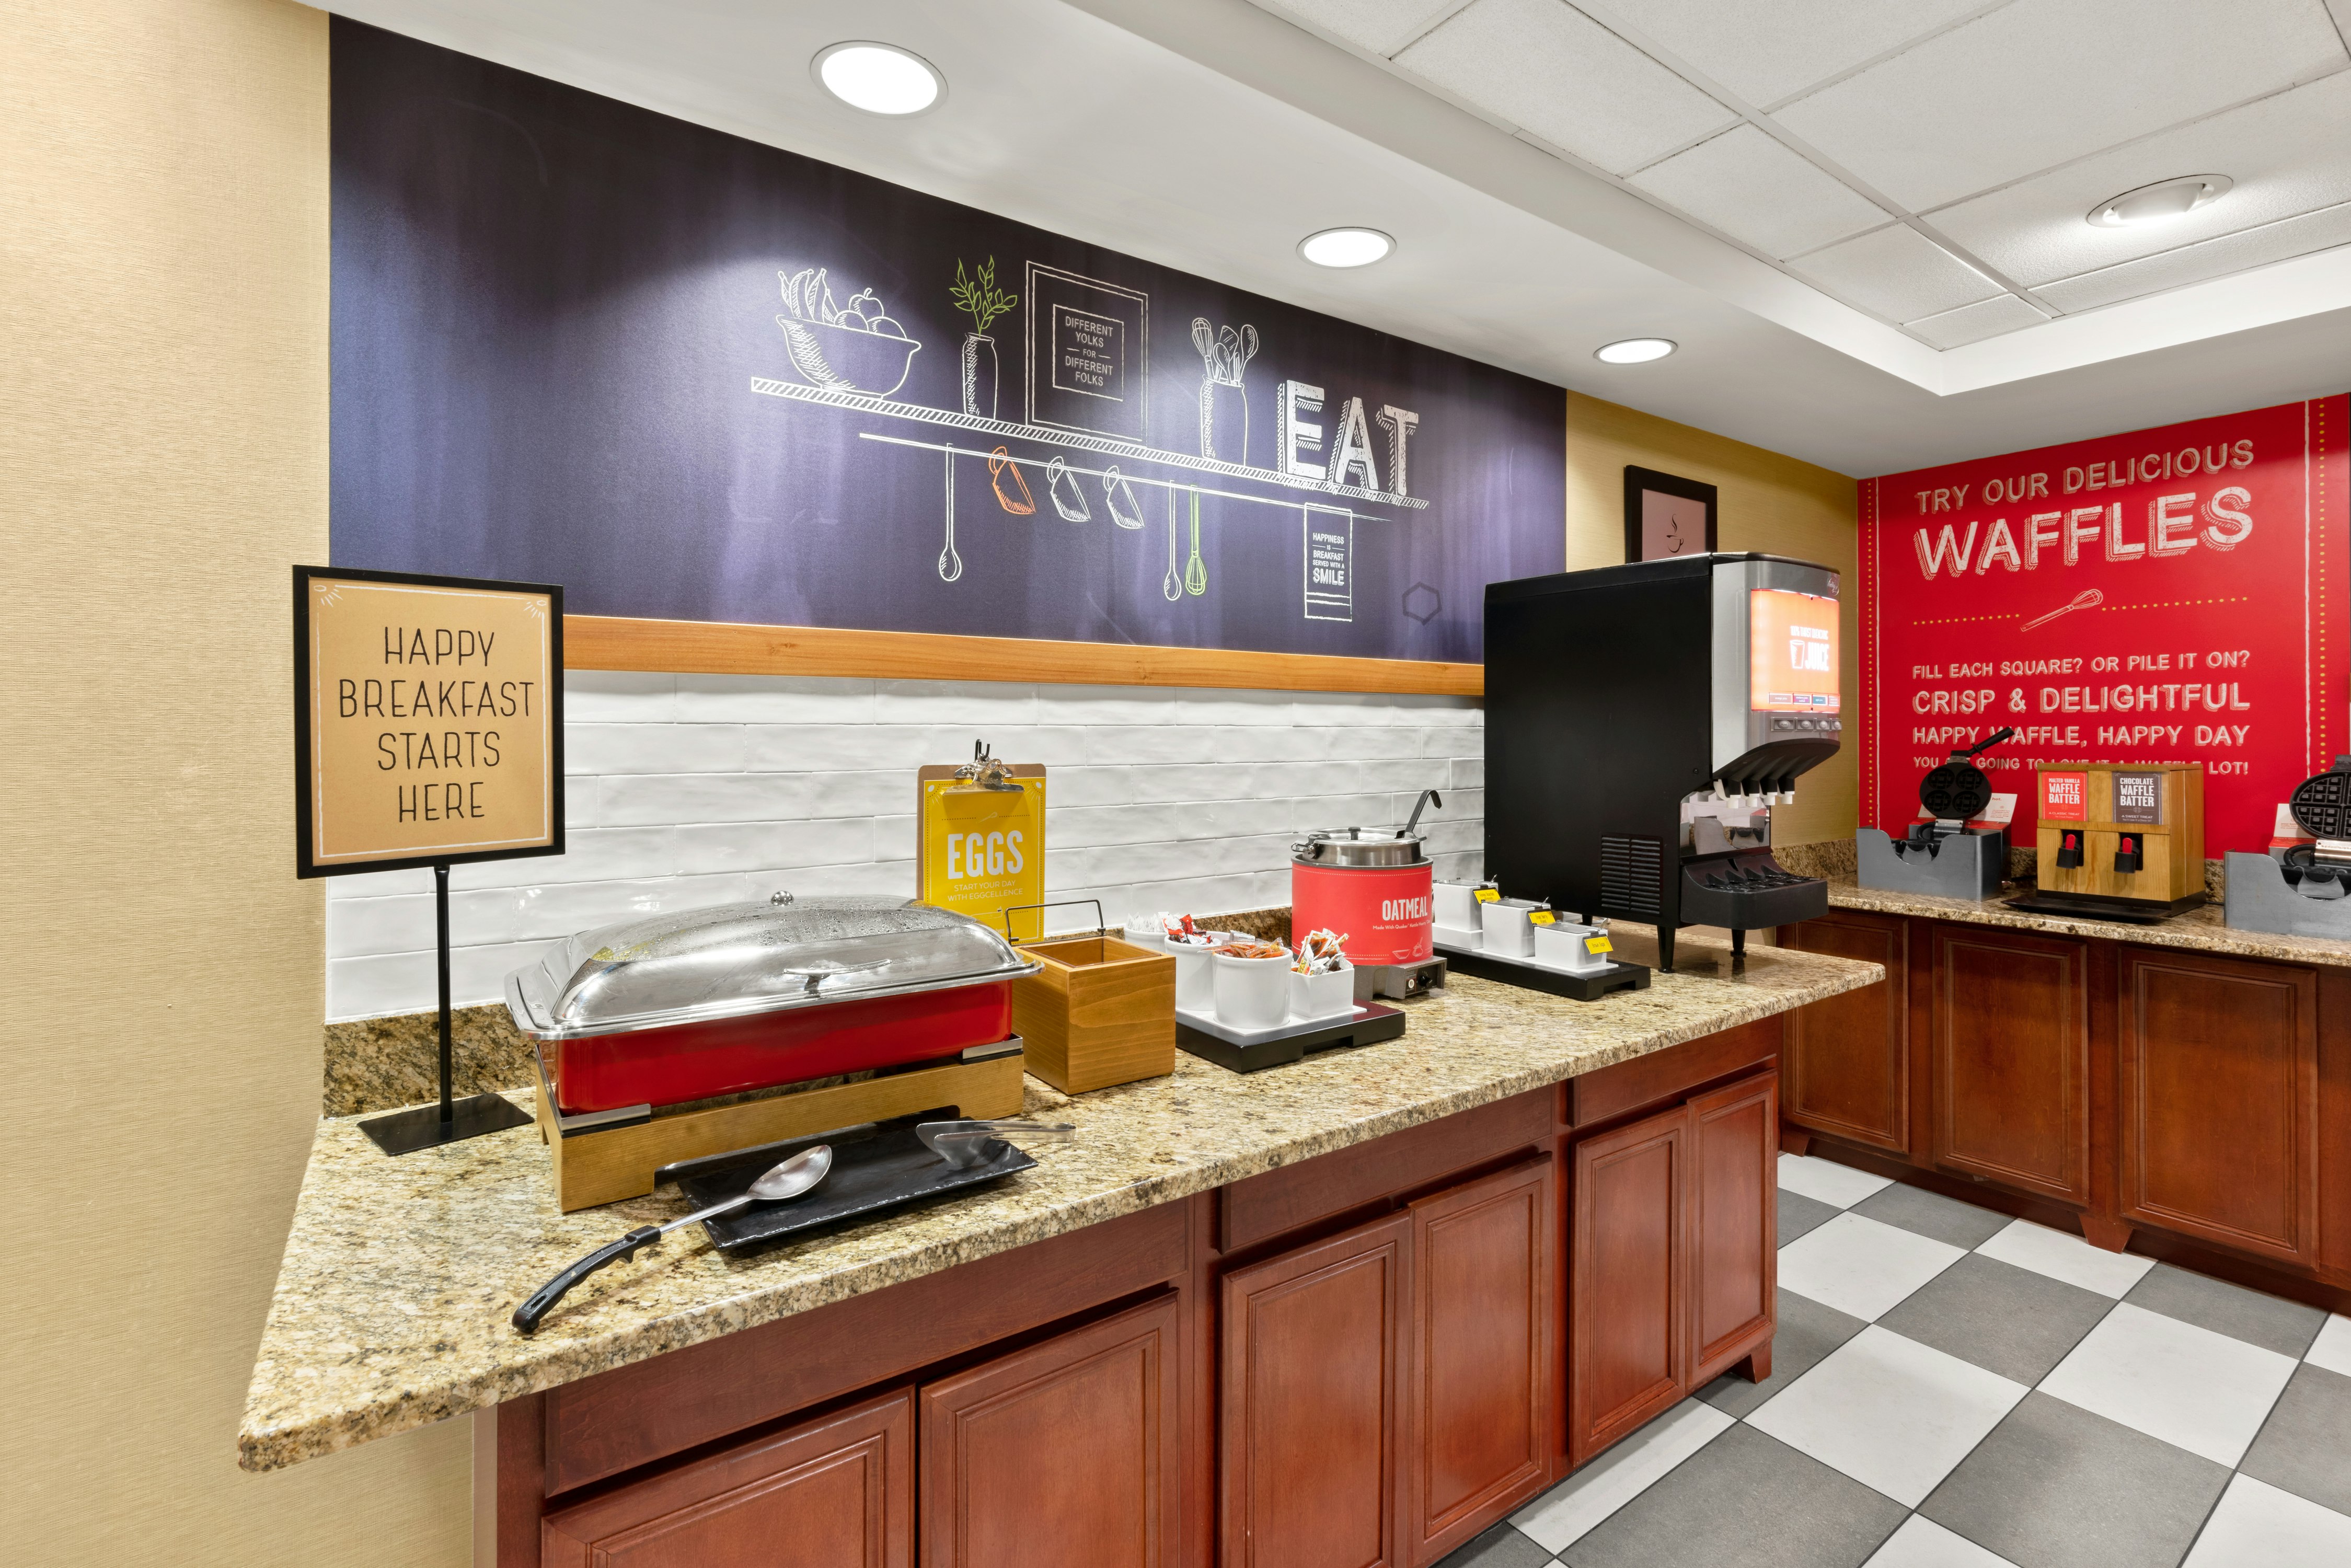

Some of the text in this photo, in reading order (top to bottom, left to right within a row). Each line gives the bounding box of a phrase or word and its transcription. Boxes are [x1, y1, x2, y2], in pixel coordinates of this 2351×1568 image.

[1065, 316, 1113, 337] DIFFERENT
[1075, 331, 1104, 348] YOLKS
[1083, 349, 1096, 359] FOR
[1065, 355, 1113, 376] DIFFERENT
[1075, 372, 1104, 386] FOLKS
[1278, 379, 1419, 499] EAT
[1915, 439, 2254, 515] TRY OUR DELICIOUS
[1312, 533, 1344, 545] HAPPINESS
[1914, 486, 2253, 581] WAFFLES
[1313, 550, 1344, 561] BREAKFAST
[1313, 568, 1344, 586] SMILE
[385, 627, 494, 666] HAPPY
[1912, 650, 2250, 679] FILL EACH SQUARE? OR PILE IT ON?
[340, 679, 534, 718] BREAKFAST
[1912, 682, 2251, 715] CRISP & DELIGHTFUL
[1912, 725, 2251, 748] HAPPY WAFFLE, HAPPY DAY
[378, 731, 500, 770] STARTS
[1913, 757, 1939, 769] YOU
[1976, 758, 2020, 770] GOING
[2208, 761, 2248, 775] LOT!
[2049, 783, 2080, 793] WAFFLE
[2049, 793, 2080, 804] BATTER
[2120, 785, 2154, 796] WAFFLE
[399, 782, 485, 823] HERE
[2120, 795, 2154, 806] BATTER
[948, 830, 1023, 880] EGGS
[947, 888, 1023, 902] WITH EGGCELLENCE
[954, 880, 1016, 892] START YOUR DAY
[1382, 896, 1427, 921] OATMEAL
